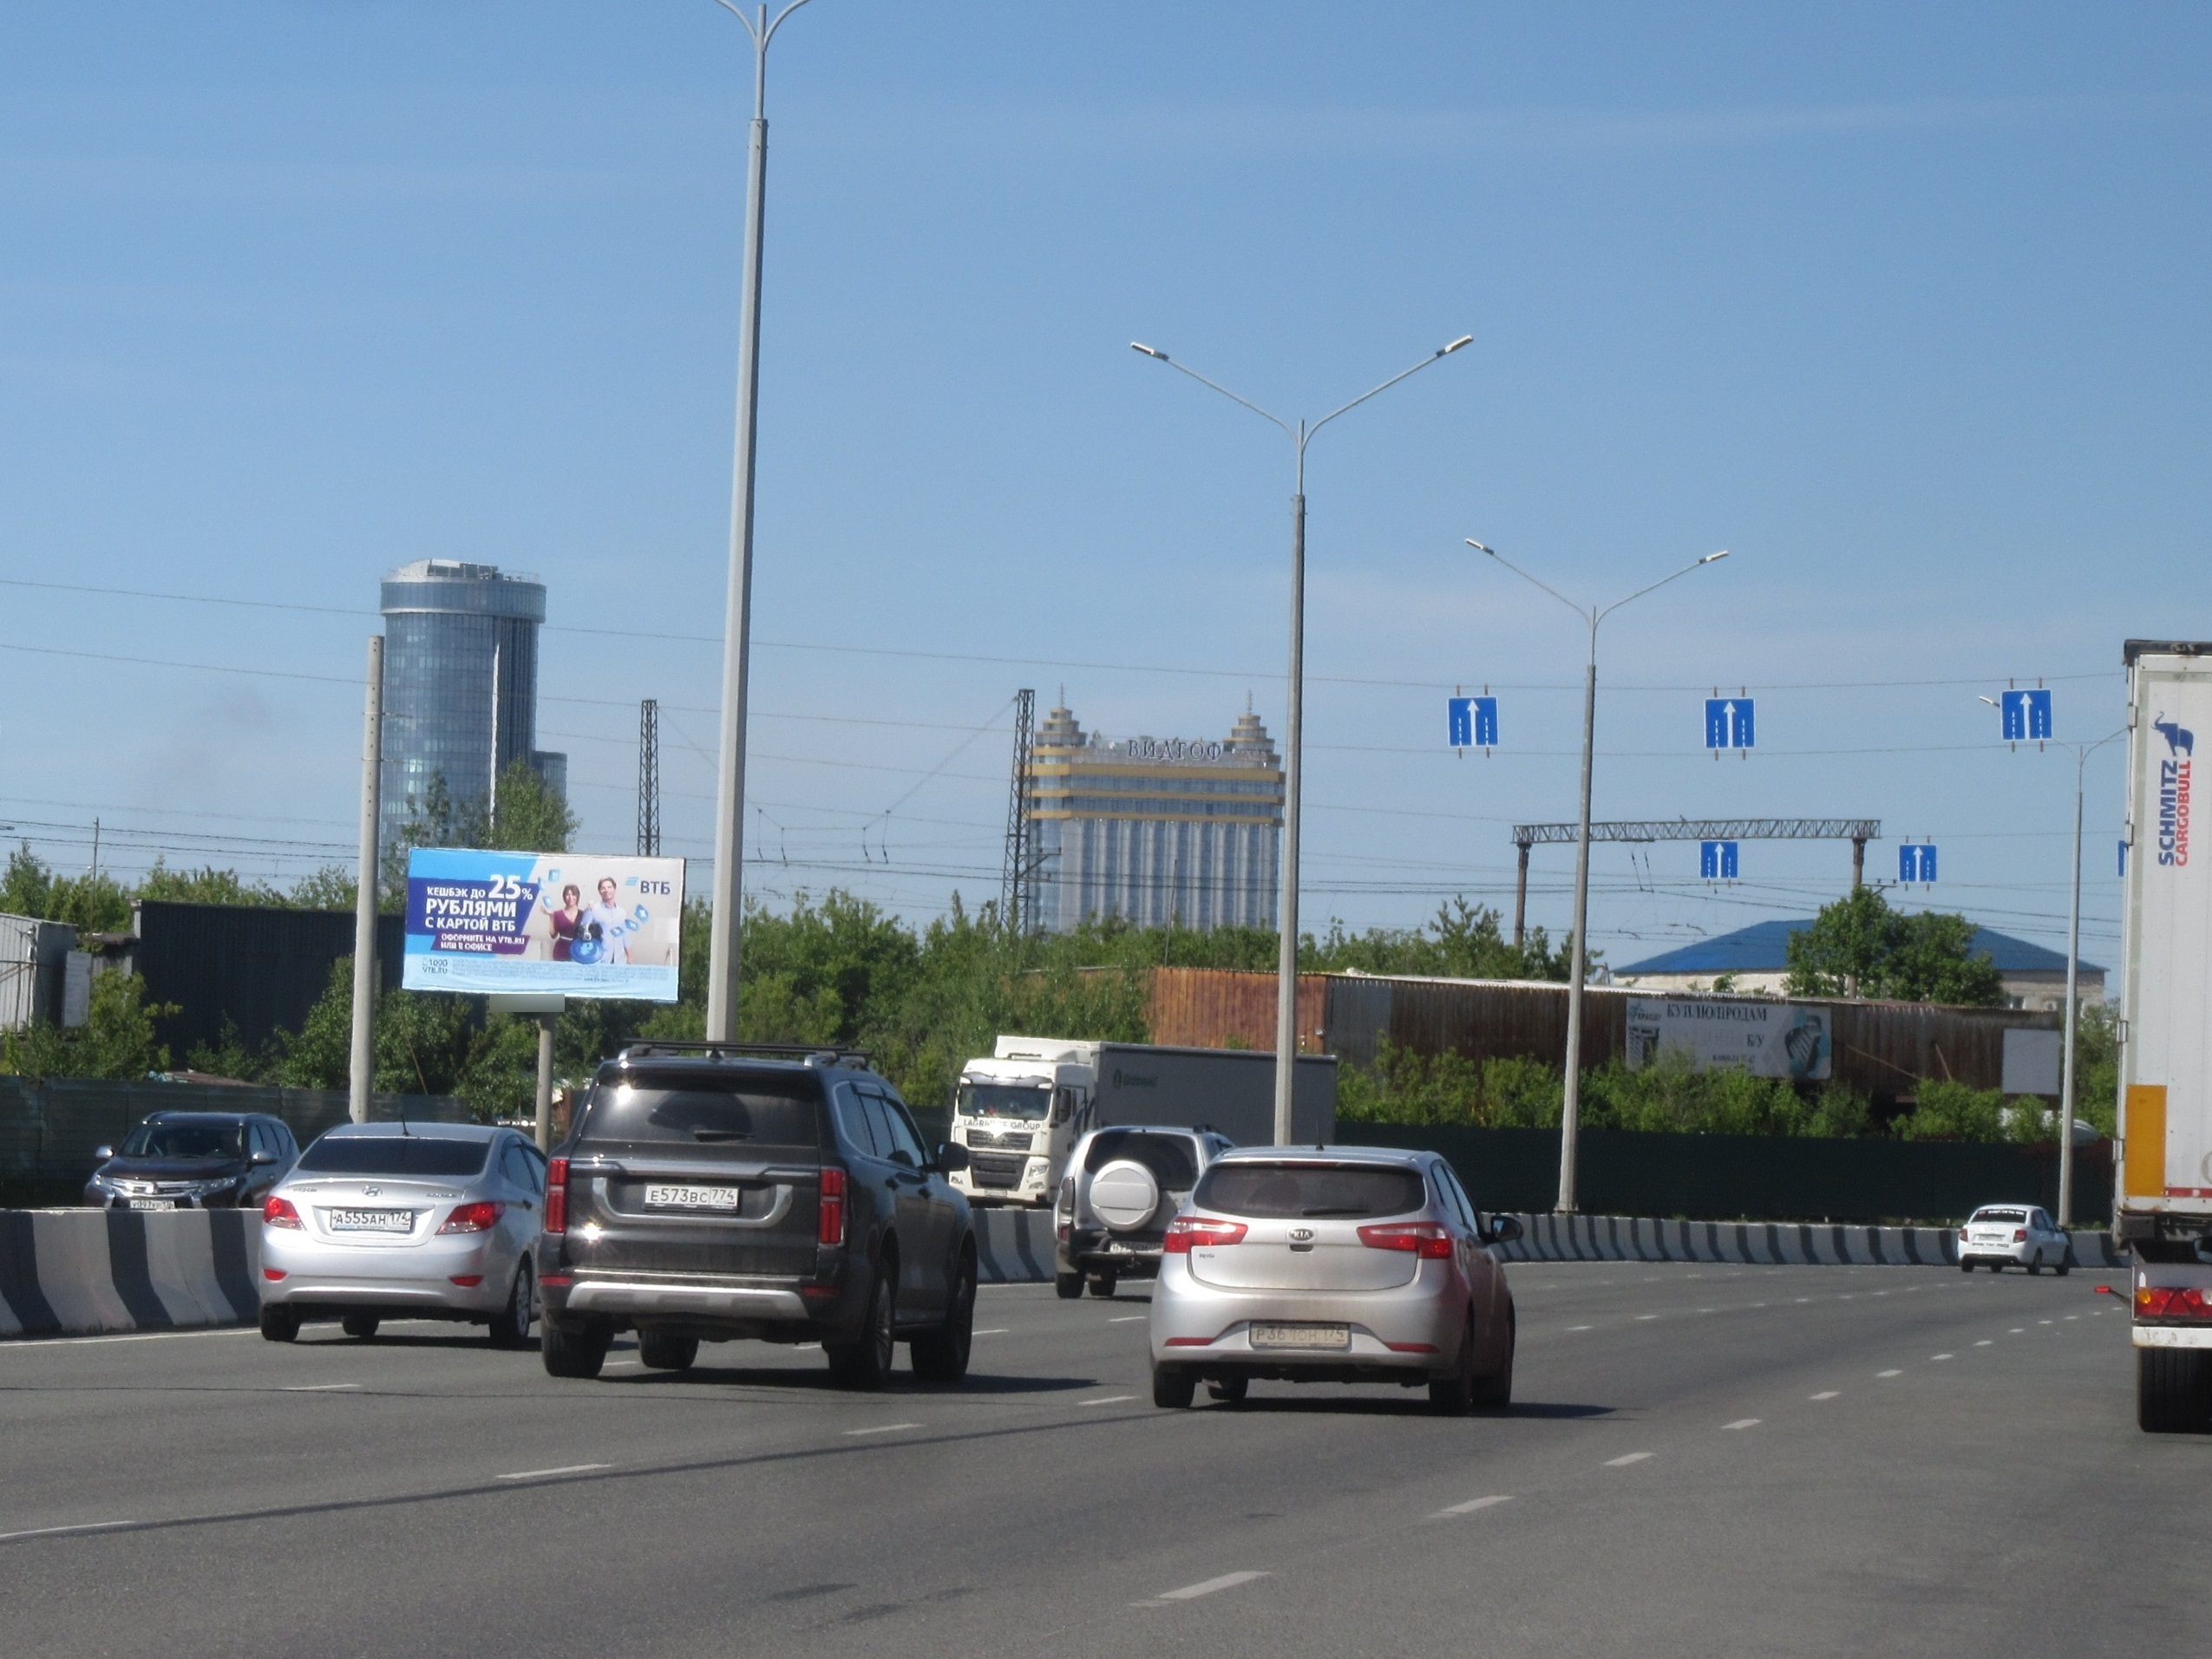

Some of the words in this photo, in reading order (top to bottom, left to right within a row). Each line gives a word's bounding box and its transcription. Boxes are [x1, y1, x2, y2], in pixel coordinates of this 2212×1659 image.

[1127, 739, 1221, 761] ВИДГОФ
[2158, 760, 2178, 865] SCHMITZ
[2176, 760, 2191, 866] CARGOBULL
[427, 886, 468, 898] КЕШБЭК
[470, 888, 486, 899] ДО
[488, 874, 533, 900] 25%
[640, 880, 671, 895] ВТБ
[425, 898, 517, 918] РУБЛЯМИ
[424, 917, 435, 929] С
[436, 918, 488, 931] КАРТОЙ
[492, 920, 516, 932] ВТБ
[441, 933, 484, 943] ОФОРМИТЕ
[464, 943, 493, 951] ОФИСЕ
[1010, 1121, 1042, 1131] GROUP
[1293, 1230, 1310, 1238] KIA
